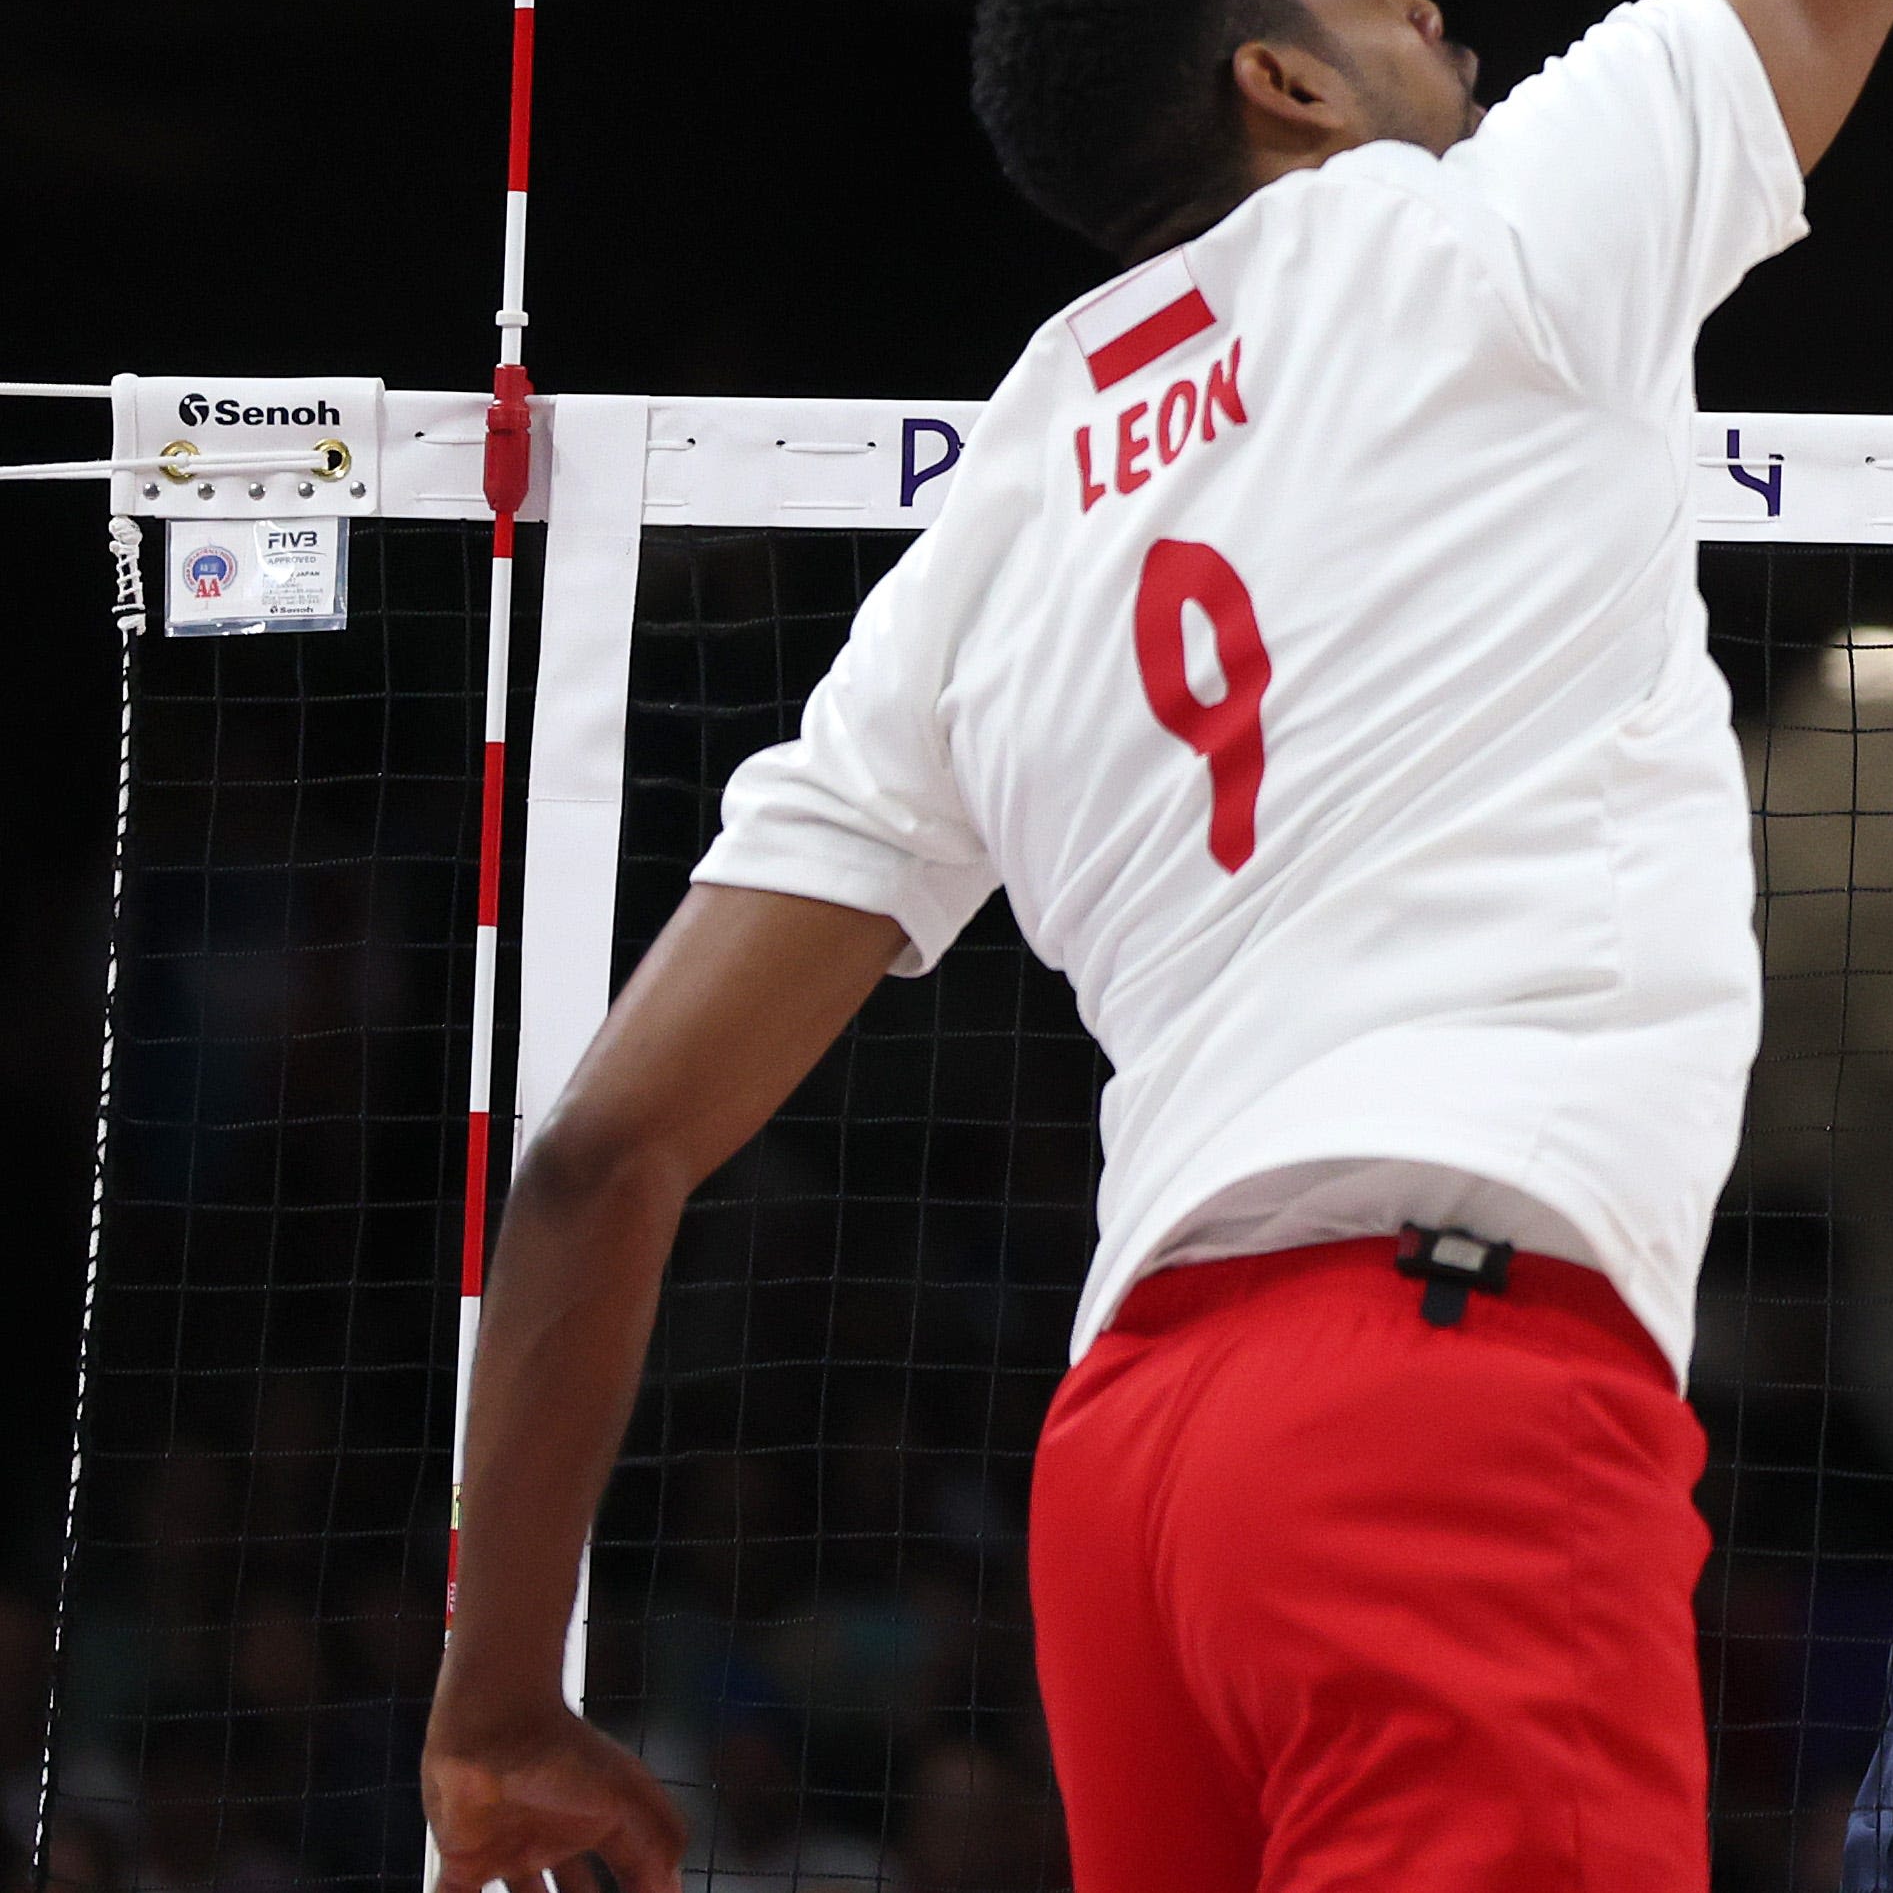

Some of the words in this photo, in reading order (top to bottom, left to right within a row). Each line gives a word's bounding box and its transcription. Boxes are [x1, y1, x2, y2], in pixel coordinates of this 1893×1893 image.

[215, 399, 341, 426] Senoh
[1075, 337, 1247, 514] LEON
[268, 531, 317, 549] FIVB
[268, 556, 316, 565] APPROVED
[195, 578, 221, 598] AA
[1134, 539, 1271, 875] 9
